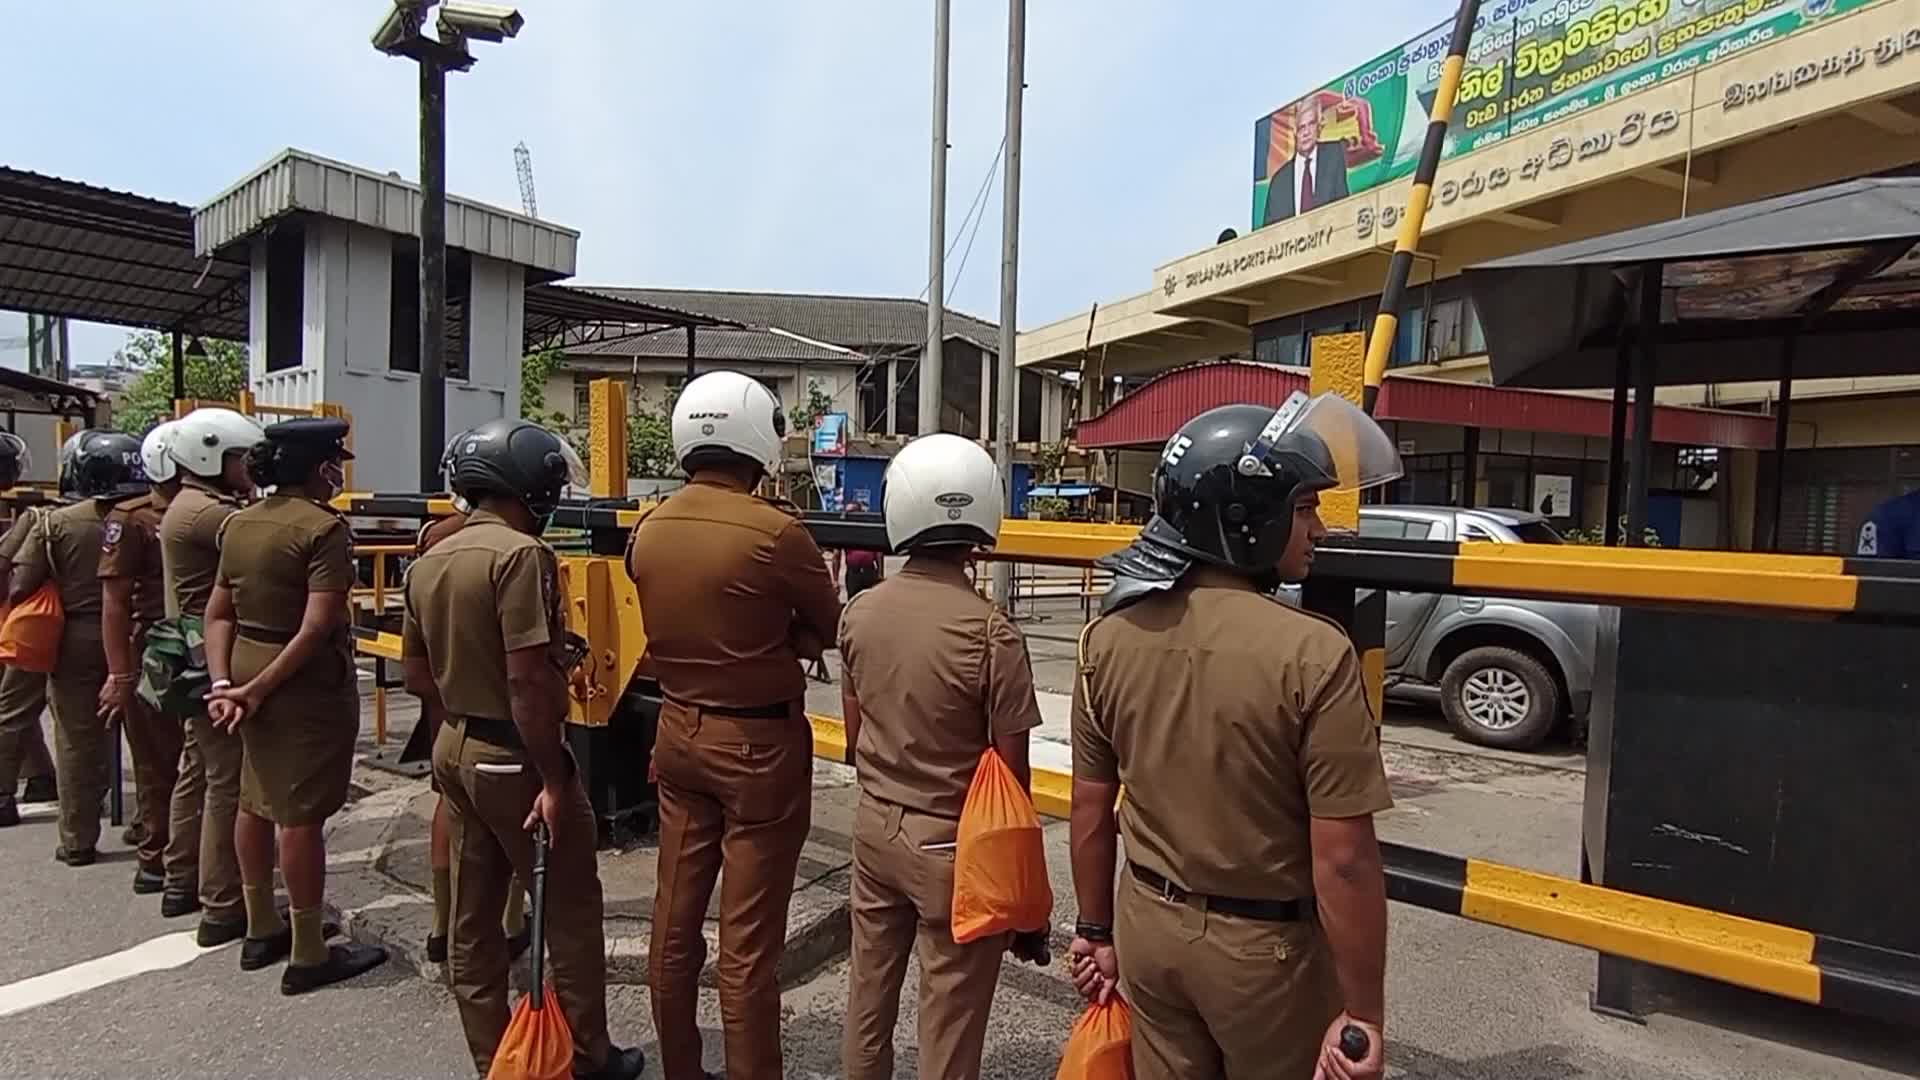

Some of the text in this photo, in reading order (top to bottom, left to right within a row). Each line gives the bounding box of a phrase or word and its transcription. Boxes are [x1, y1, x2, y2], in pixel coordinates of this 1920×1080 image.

[1359, 61, 1394, 92] ලංකා
[1621, 72, 1656, 95] ලංකා
[1662, 57, 1699, 77] වරාය
[1440, 167, 1510, 206] වරාය
[1233, 249, 1265, 273] PORTS
[1267, 226, 1333, 262] AUTHORITY
